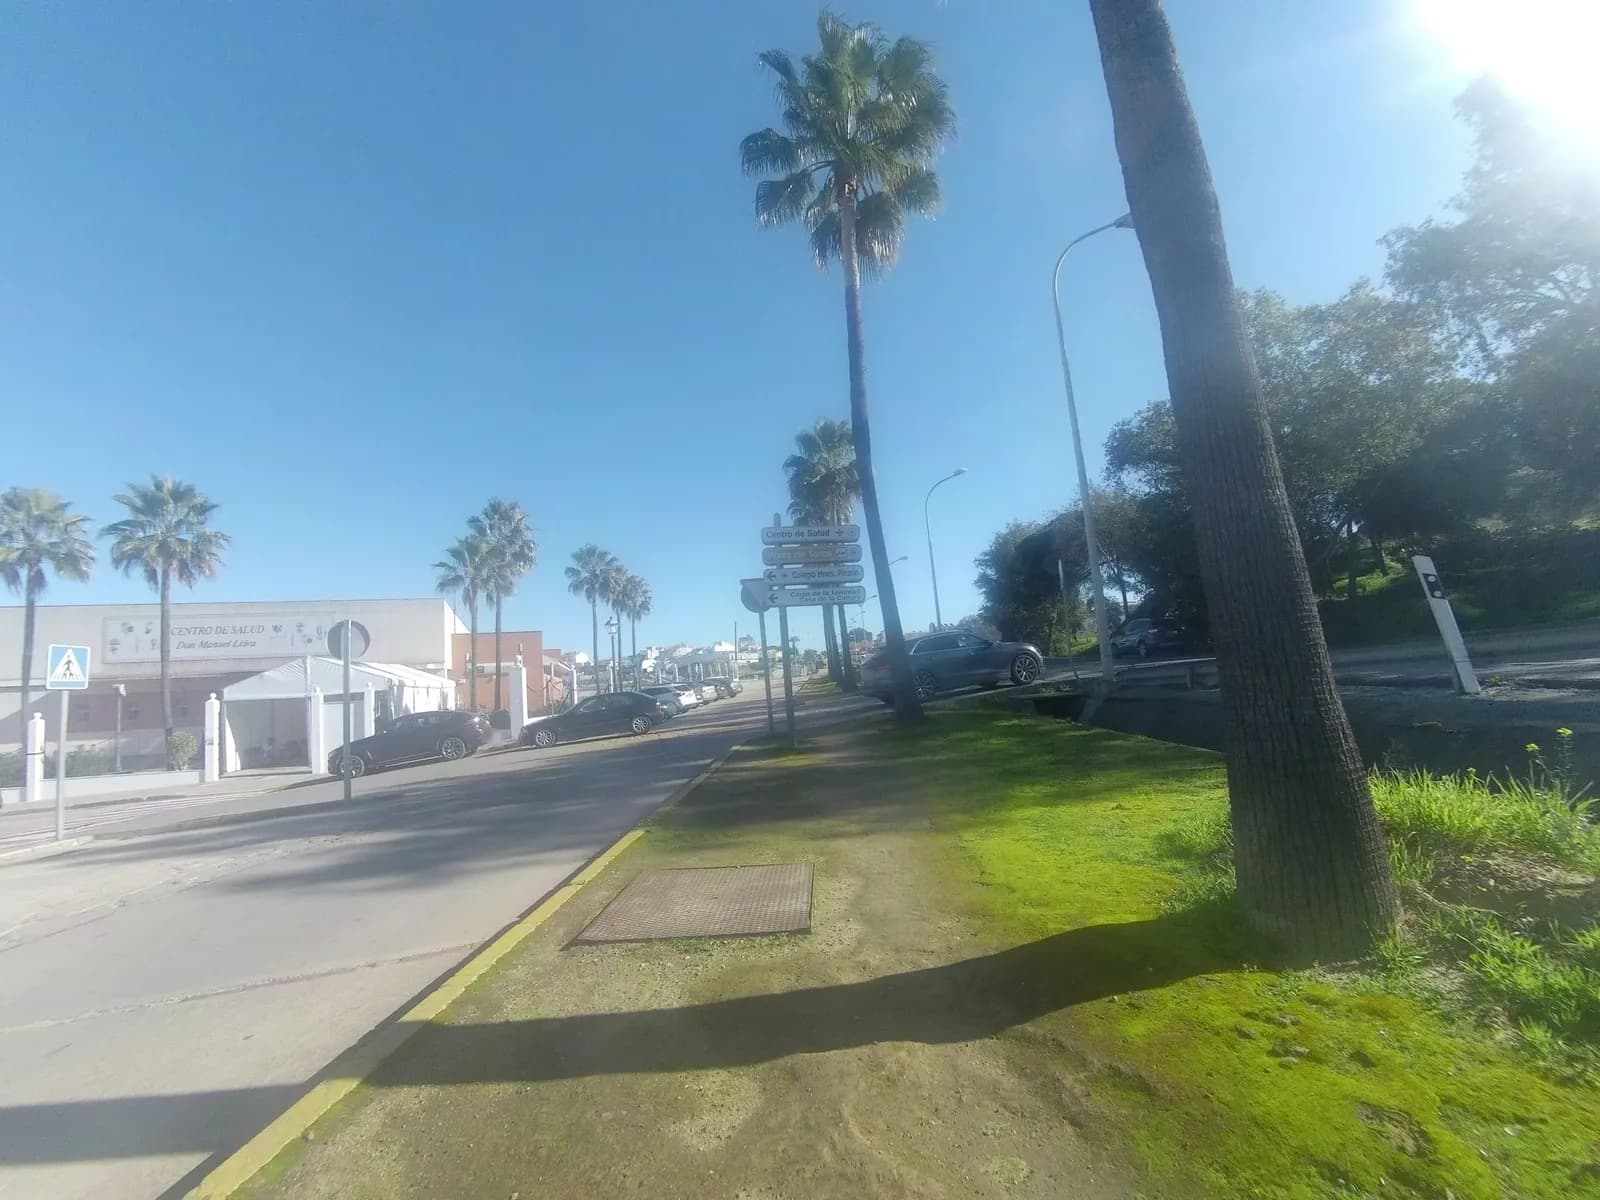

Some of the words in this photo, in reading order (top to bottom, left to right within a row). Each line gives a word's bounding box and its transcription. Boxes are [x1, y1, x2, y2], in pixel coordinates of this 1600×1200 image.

[766, 530, 792, 538] Centro
[807, 528, 830, 537] Salud
[170, 626, 213, 636] CENTRO
[215, 625, 229, 635] DE
[230, 624, 265, 634] SALUD
